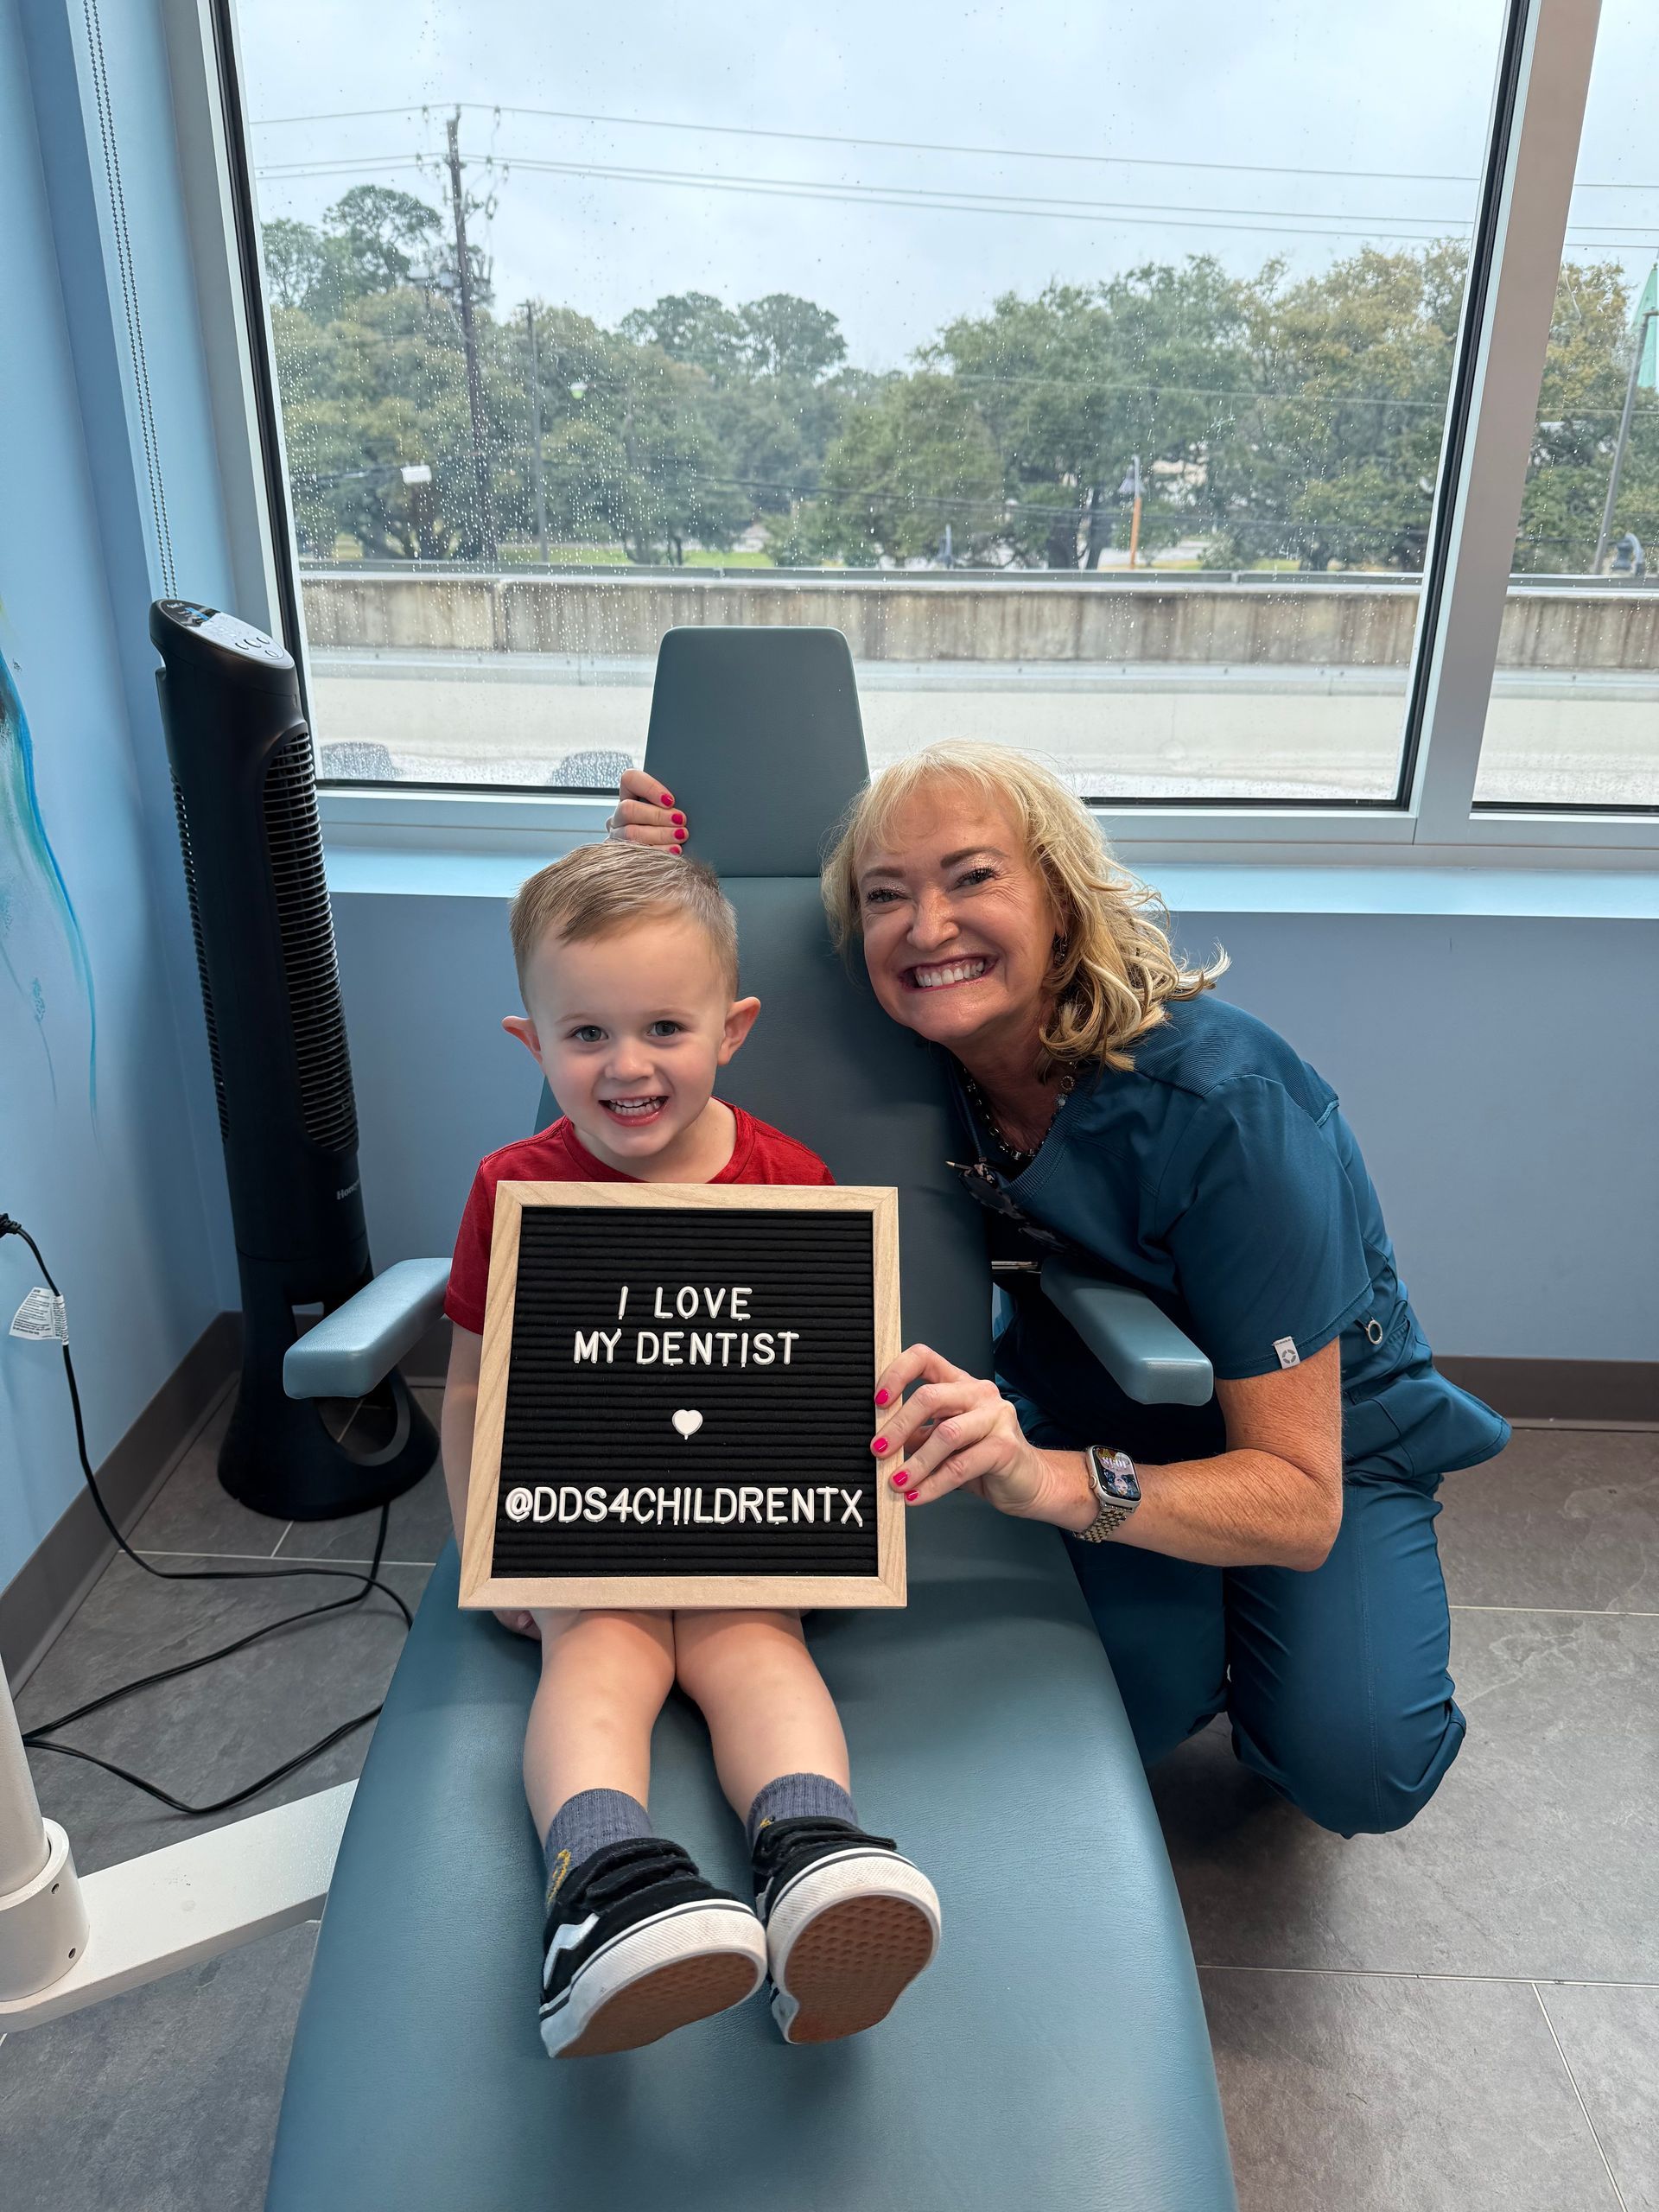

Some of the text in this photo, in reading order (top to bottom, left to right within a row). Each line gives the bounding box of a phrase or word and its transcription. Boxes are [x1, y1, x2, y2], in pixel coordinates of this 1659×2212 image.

[618, 1286, 753, 1321] I LOVE
[574, 1328, 800, 1368] MY DENTIST
[505, 1486, 863, 1528] @DDS4CHILDRENTX
